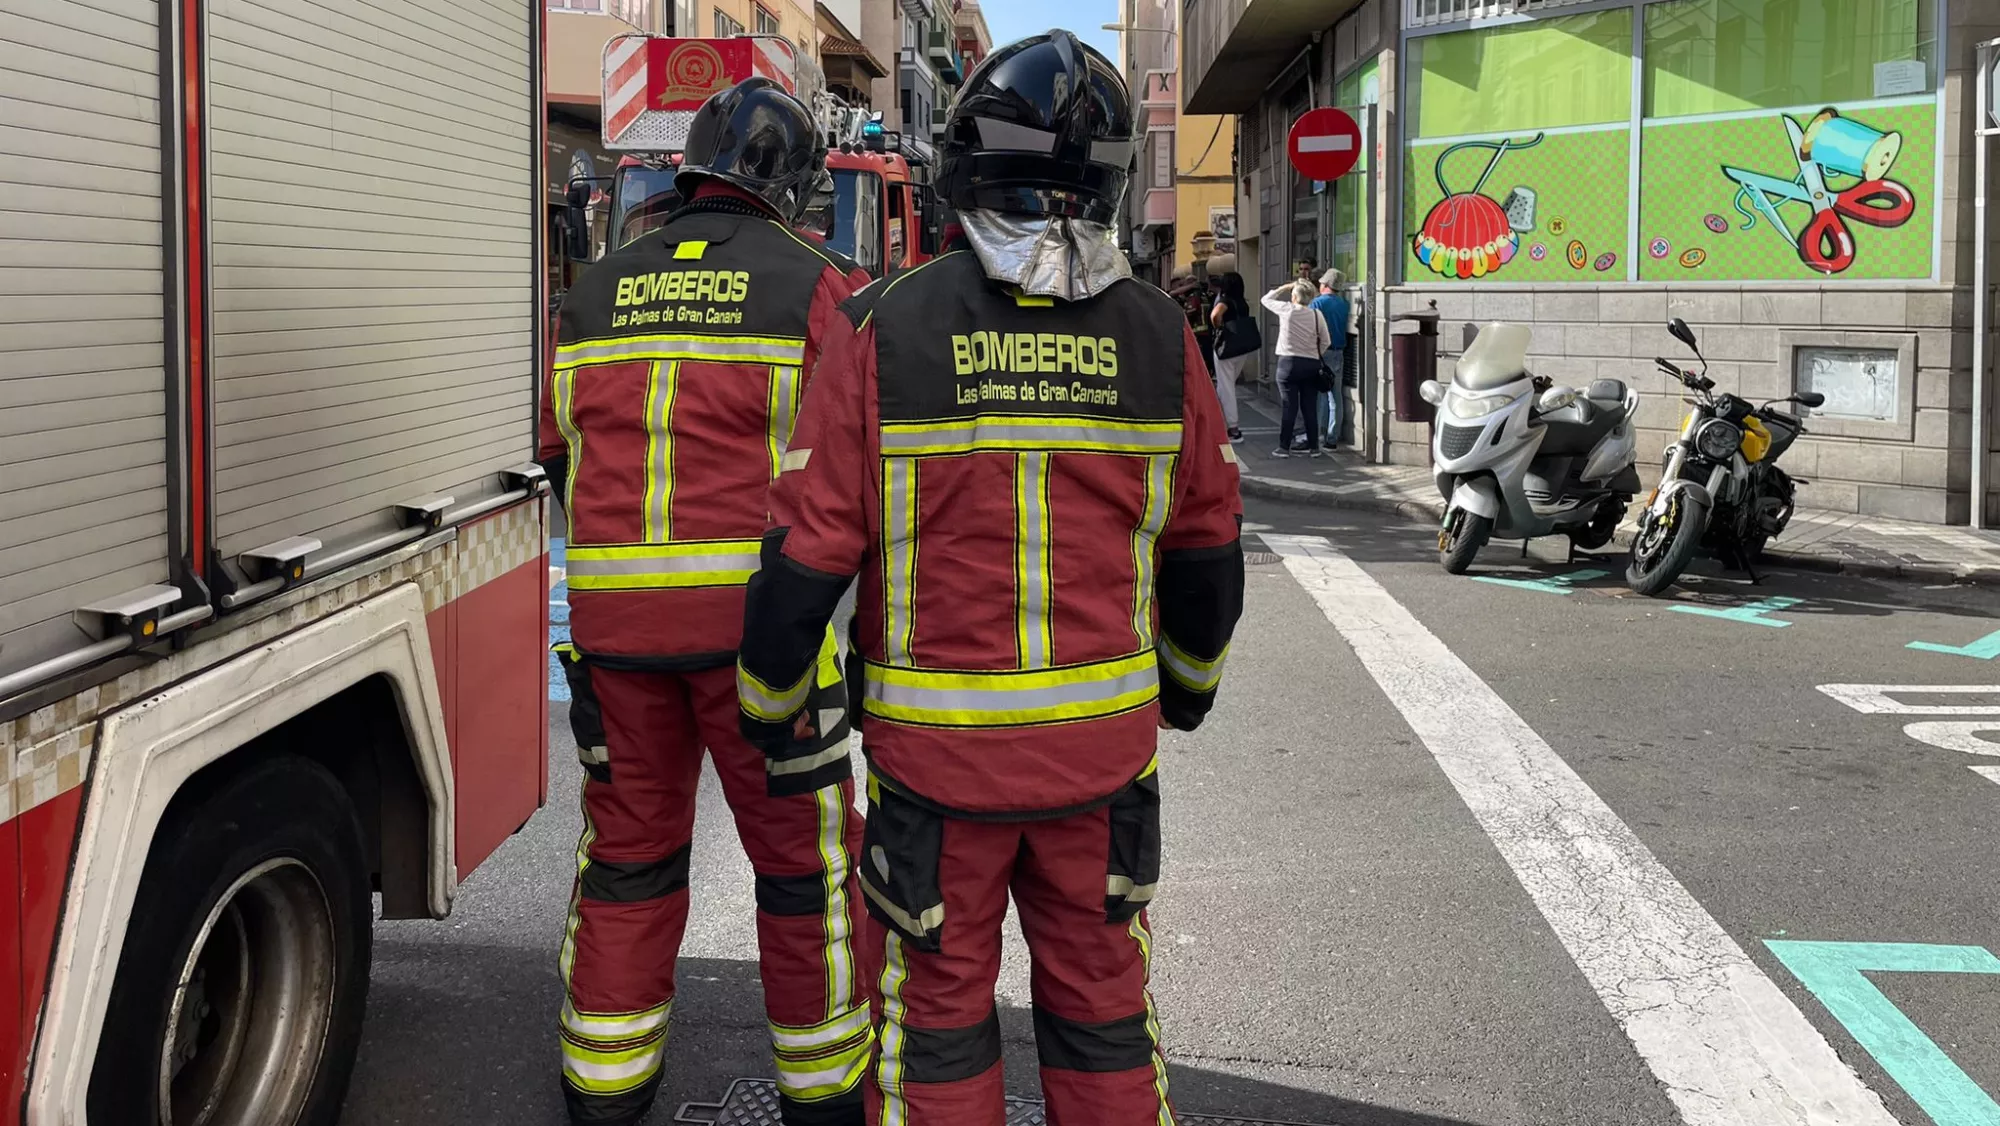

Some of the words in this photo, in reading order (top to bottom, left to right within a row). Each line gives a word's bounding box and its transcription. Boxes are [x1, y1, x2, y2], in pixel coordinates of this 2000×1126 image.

[615, 270, 750, 306] BOMBEROS
[612, 312, 627, 328] Las
[630, 309, 660, 326] Palmas
[662, 306, 674, 322] de
[677, 306, 703, 323] Gran
[706, 307, 743, 324] Canaria
[951, 330, 1118, 377] BOMBEROS
[956, 383, 978, 405] Las
[1020, 380, 1035, 401] de
[1038, 380, 1069, 402] Gran
[1070, 381, 1118, 406] Canaria
